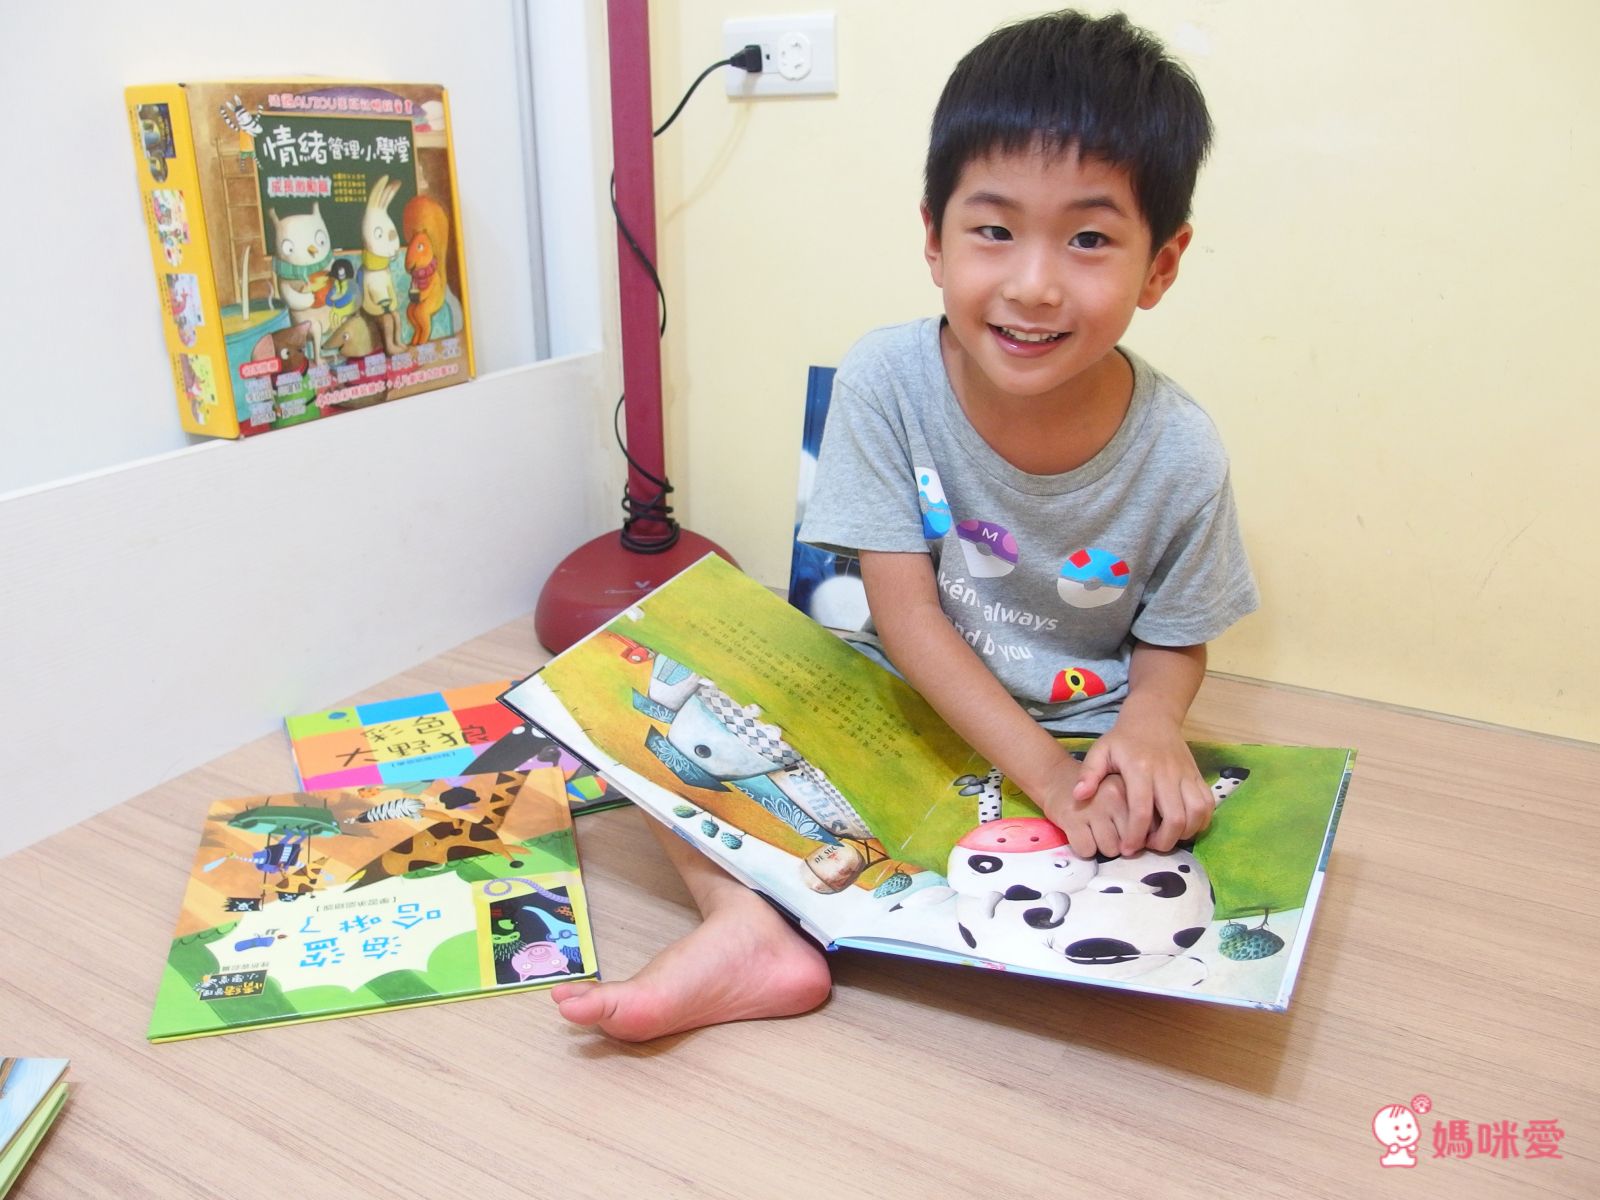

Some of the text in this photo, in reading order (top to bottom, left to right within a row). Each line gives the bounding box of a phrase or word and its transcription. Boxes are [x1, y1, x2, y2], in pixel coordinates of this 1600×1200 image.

[263, 124, 411, 168] 情緒管理小學堂
[982, 528, 998, 542] M
[983, 602, 1059, 631] always
[998, 643, 1034, 662] you
[360, 716, 445, 743] 彩色
[335, 725, 489, 768] 大野狼
[299, 903, 442, 934] 哈啾了
[299, 936, 402, 968] 海盜
